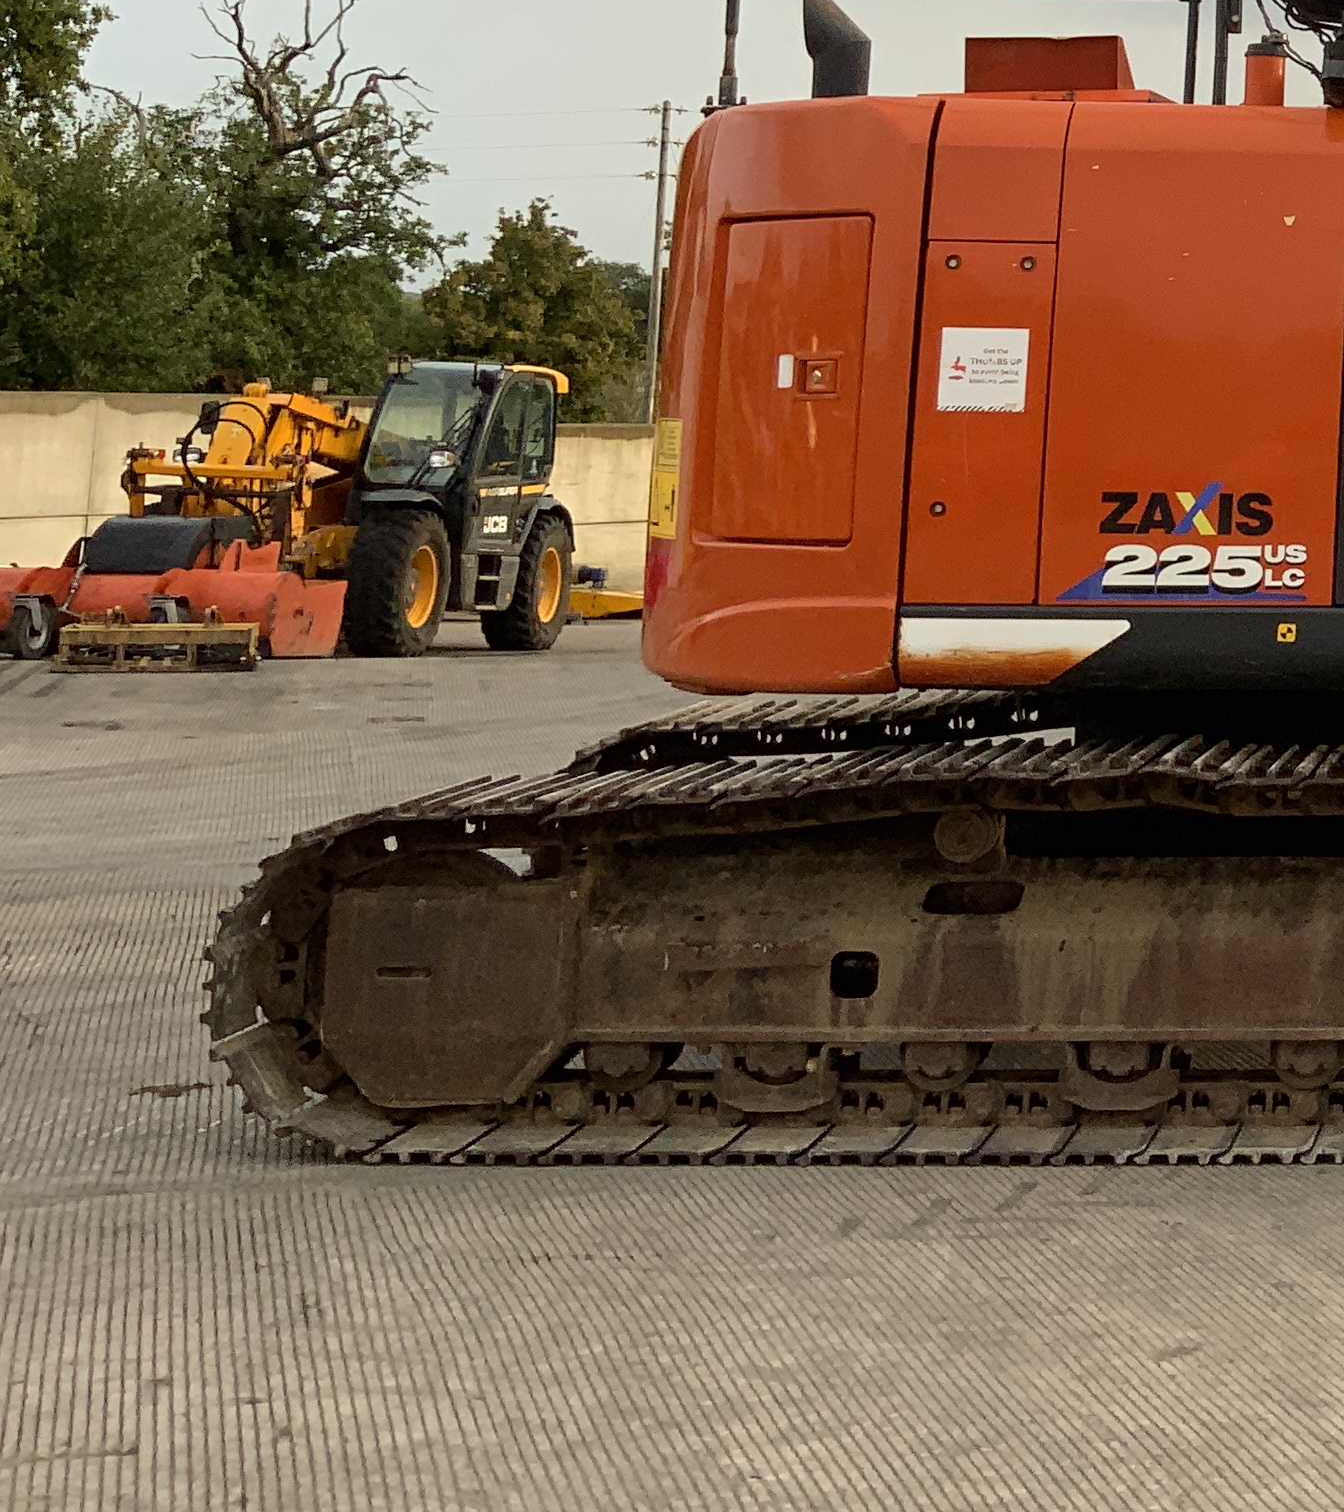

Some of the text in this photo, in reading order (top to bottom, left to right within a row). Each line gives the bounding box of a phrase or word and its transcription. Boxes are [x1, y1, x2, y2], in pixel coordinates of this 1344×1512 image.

[483, 515, 508, 534] JCB
[1099, 481, 1274, 536] ZAXIS
[1100, 543, 1308, 594] 225 US
[1264, 568, 1306, 589] LC
